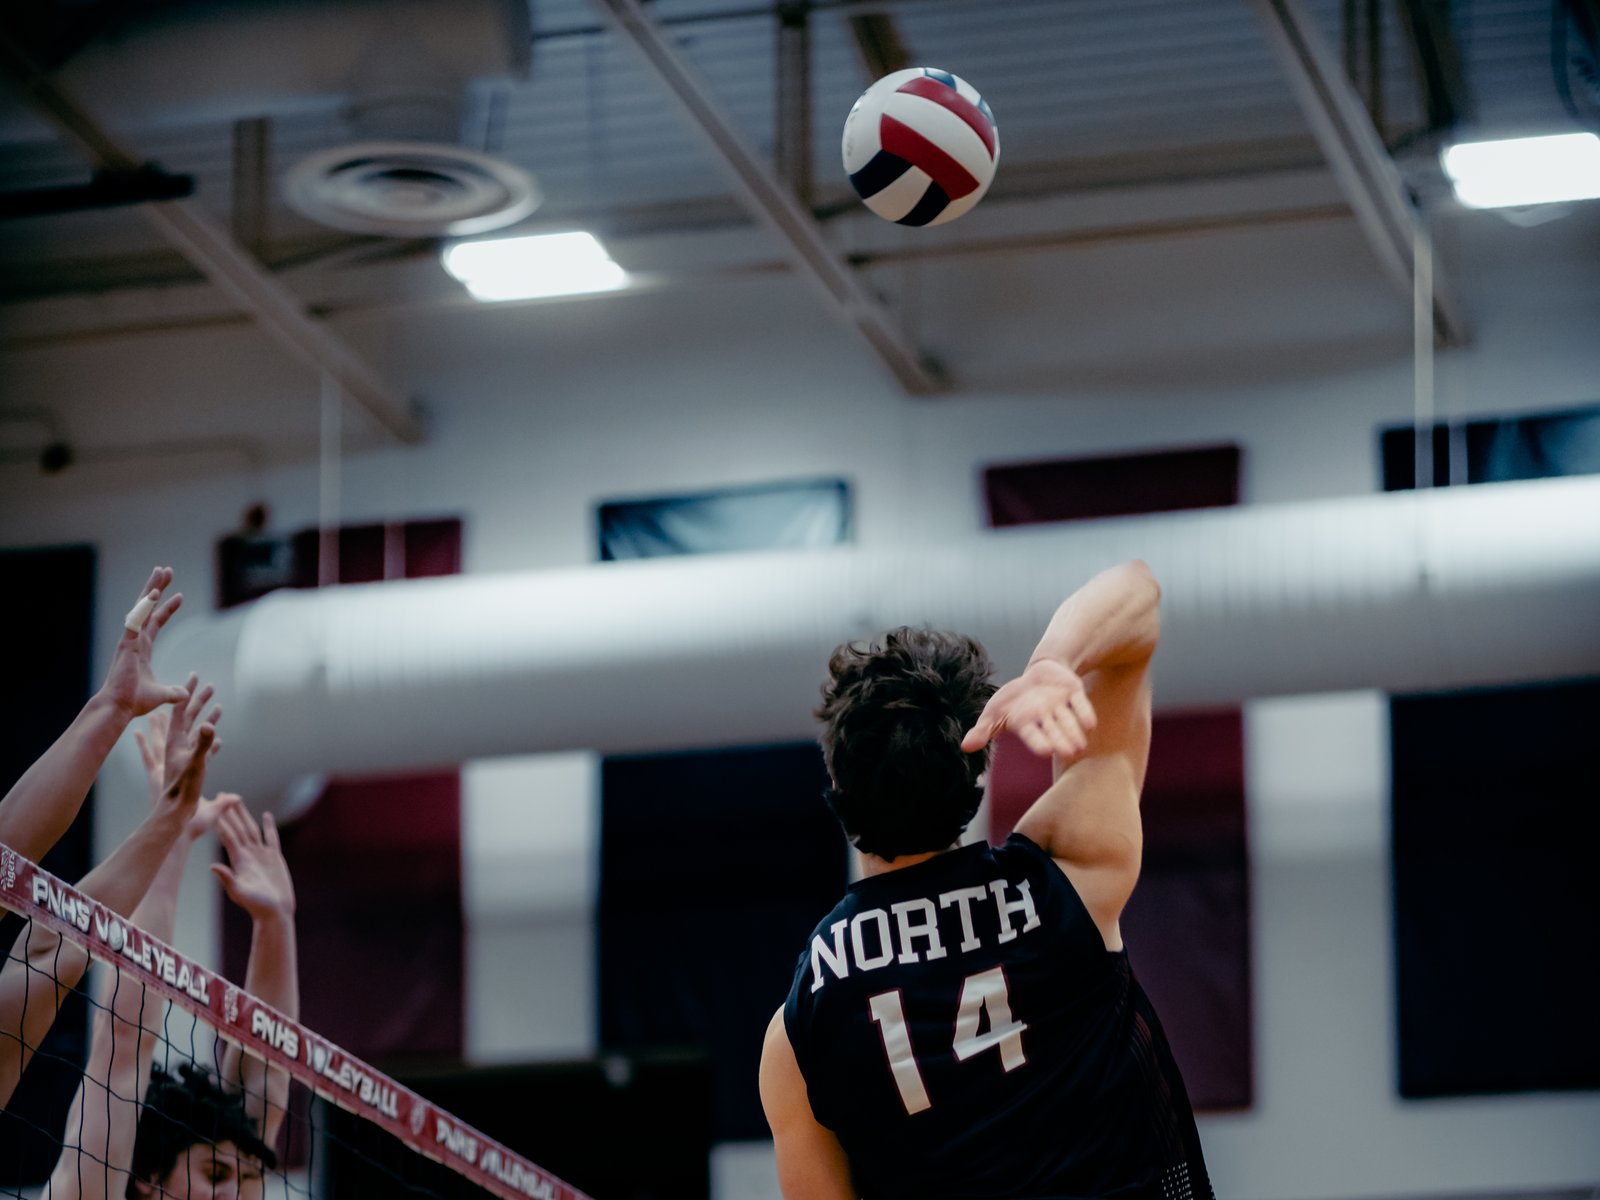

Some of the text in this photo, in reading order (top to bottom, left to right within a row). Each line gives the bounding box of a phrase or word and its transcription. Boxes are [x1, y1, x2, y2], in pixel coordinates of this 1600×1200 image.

[32, 874, 90, 934] PNHS
[95, 909, 210, 1006] VOLLEYBALL
[810, 878, 1042, 994] NORTH
[252, 1008, 299, 1060] PNHS
[868, 963, 1031, 1116] 14
